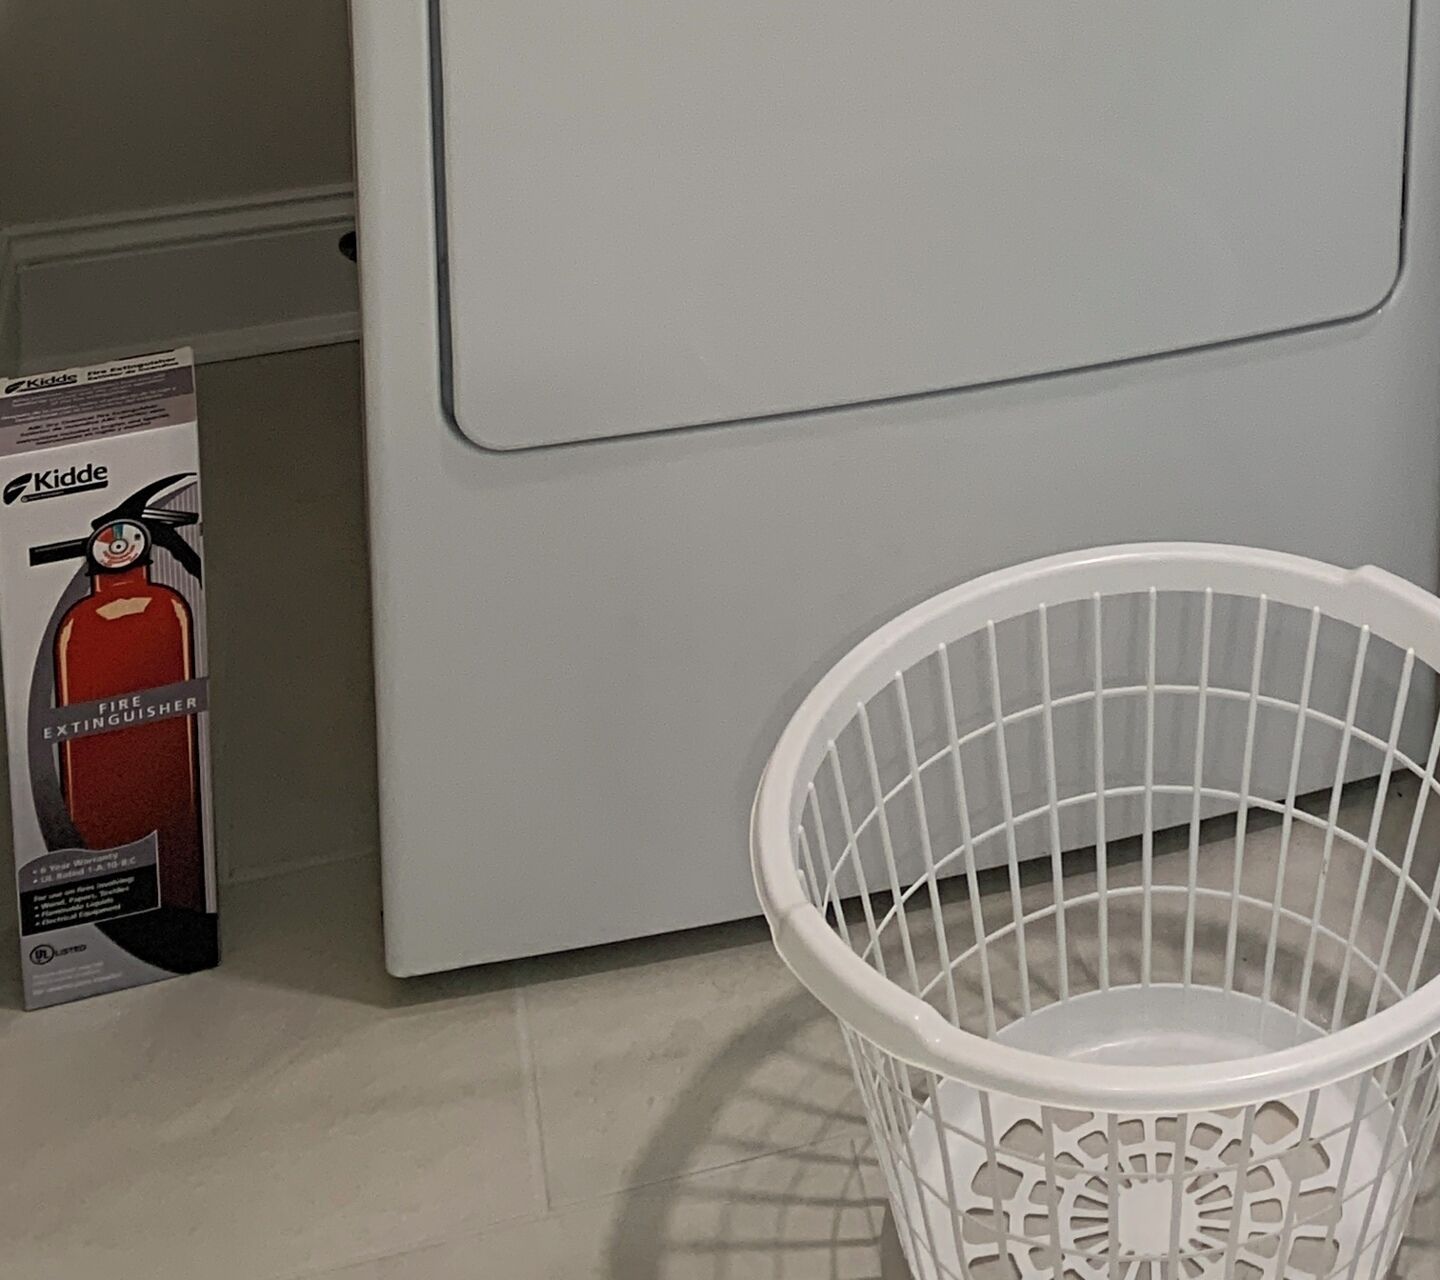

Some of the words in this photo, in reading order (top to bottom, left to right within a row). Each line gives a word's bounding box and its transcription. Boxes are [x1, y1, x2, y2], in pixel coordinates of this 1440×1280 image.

[26, 373, 78, 389] Kidde
[34, 463, 109, 492] Kidde
[99, 695, 142, 714] FIRE
[43, 696, 198, 740] EXTINGUISHER
[49, 861, 71, 872] Year
[73, 852, 119, 867] Warranty
[56, 869, 85, 880] Rated
[33, 894, 48, 903] For
